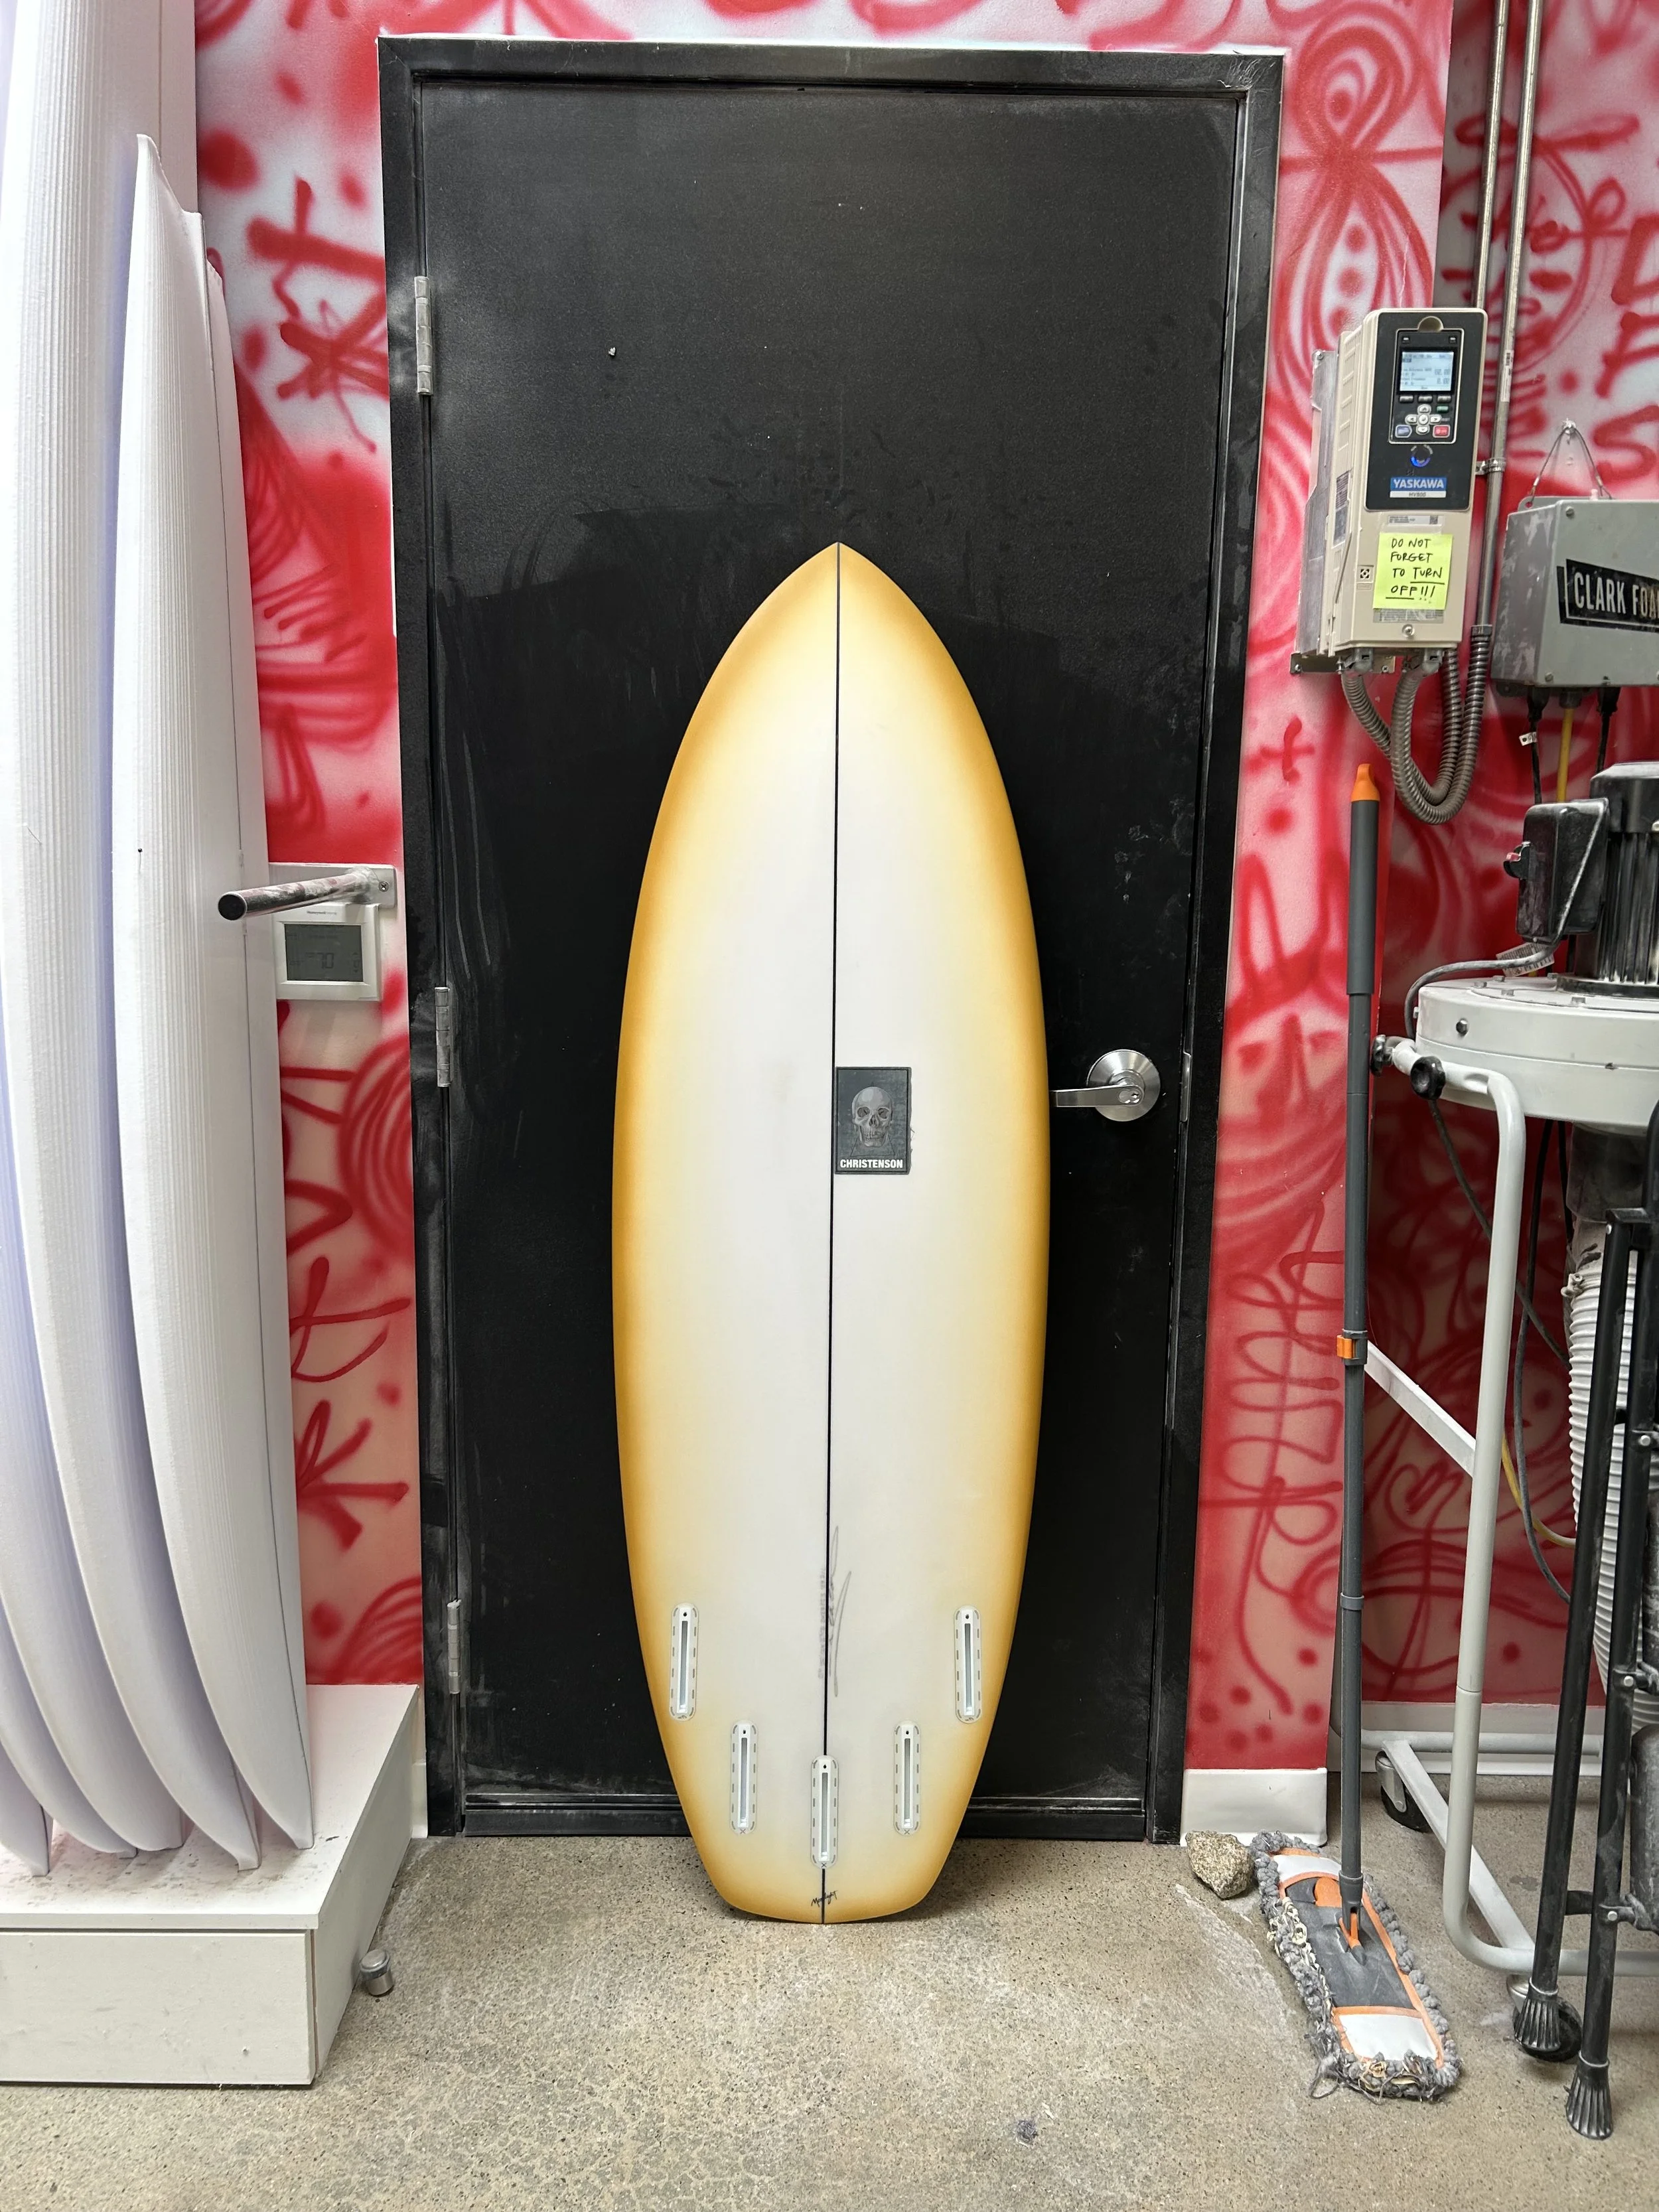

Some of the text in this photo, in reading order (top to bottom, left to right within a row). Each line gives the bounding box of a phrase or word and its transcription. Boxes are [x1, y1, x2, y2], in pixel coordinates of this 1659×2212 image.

[1394, 479, 1444, 488] YASKAWA
[1391, 538, 1431, 549] DO NOT
[1390, 552, 1433, 562] FORGET
[1392, 567, 1443, 579] TO TURN
[1390, 585, 1435, 604] OFF!!!
[1574, 571, 1659, 620] CLARK FOA
[840, 1159, 903, 1169] CHRISTENSON
[810, 1890, 838, 1908] Molight
